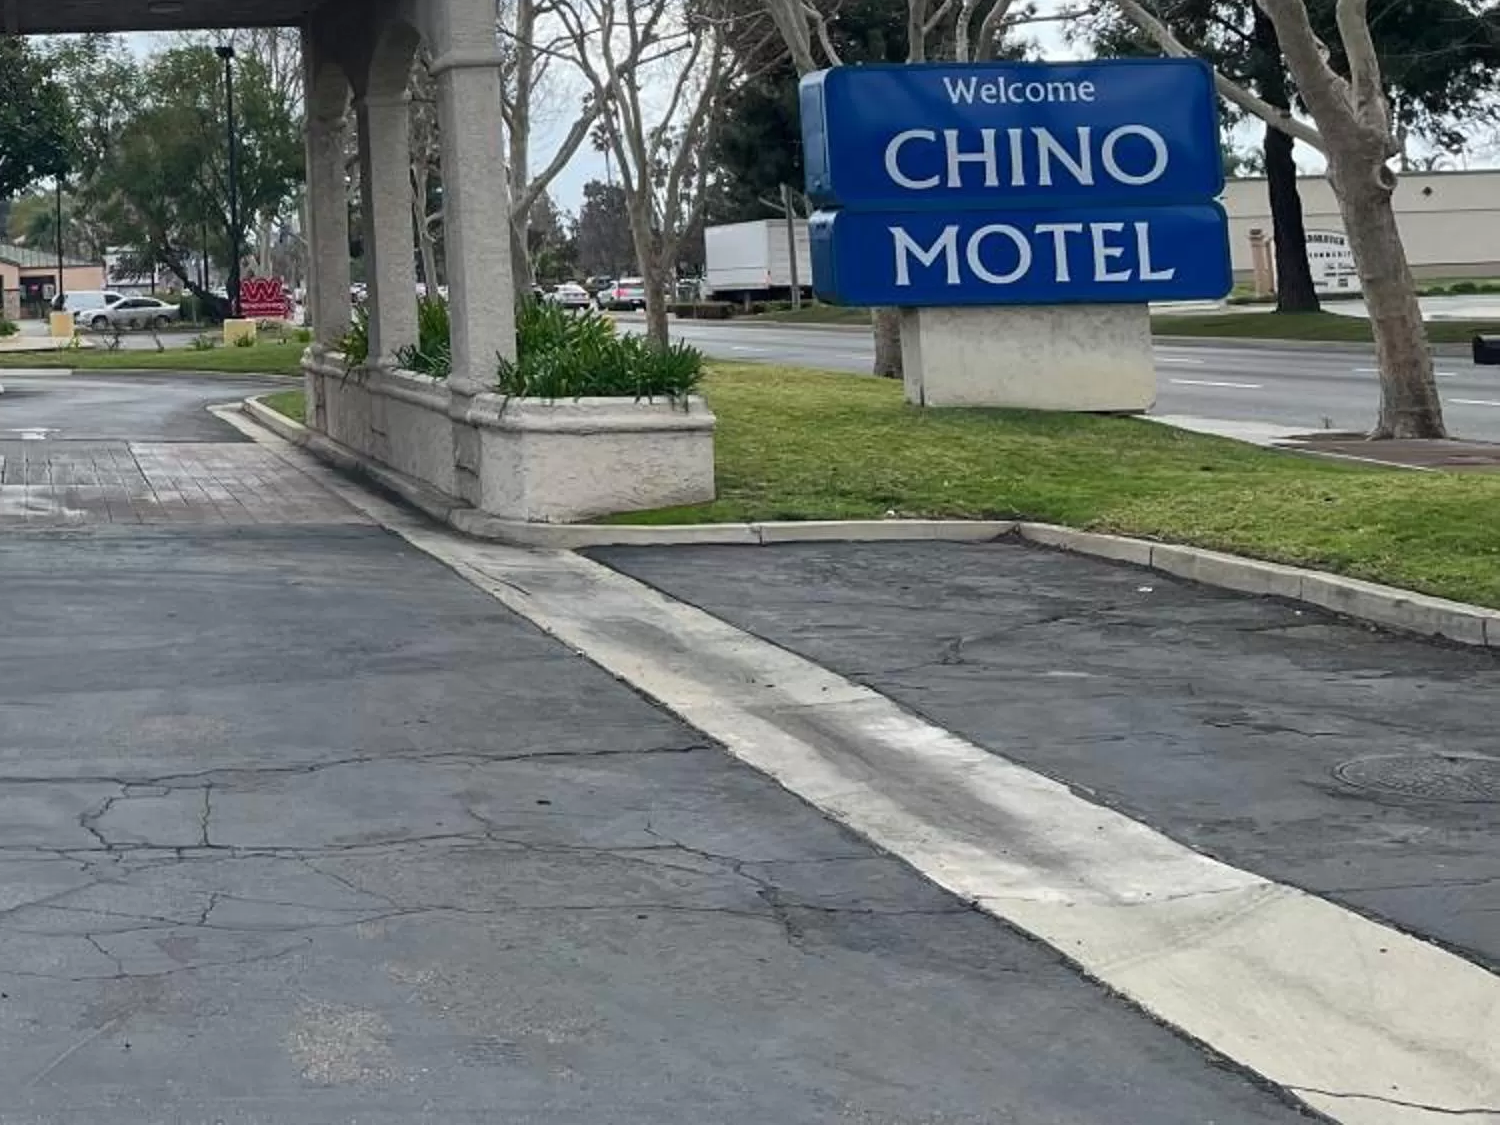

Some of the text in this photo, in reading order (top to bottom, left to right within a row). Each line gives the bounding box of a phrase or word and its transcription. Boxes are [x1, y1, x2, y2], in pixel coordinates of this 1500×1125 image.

[942, 75, 1096, 105] Welcome
[884, 123, 1169, 190] CHINO
[888, 221, 1176, 286] MOTEL
